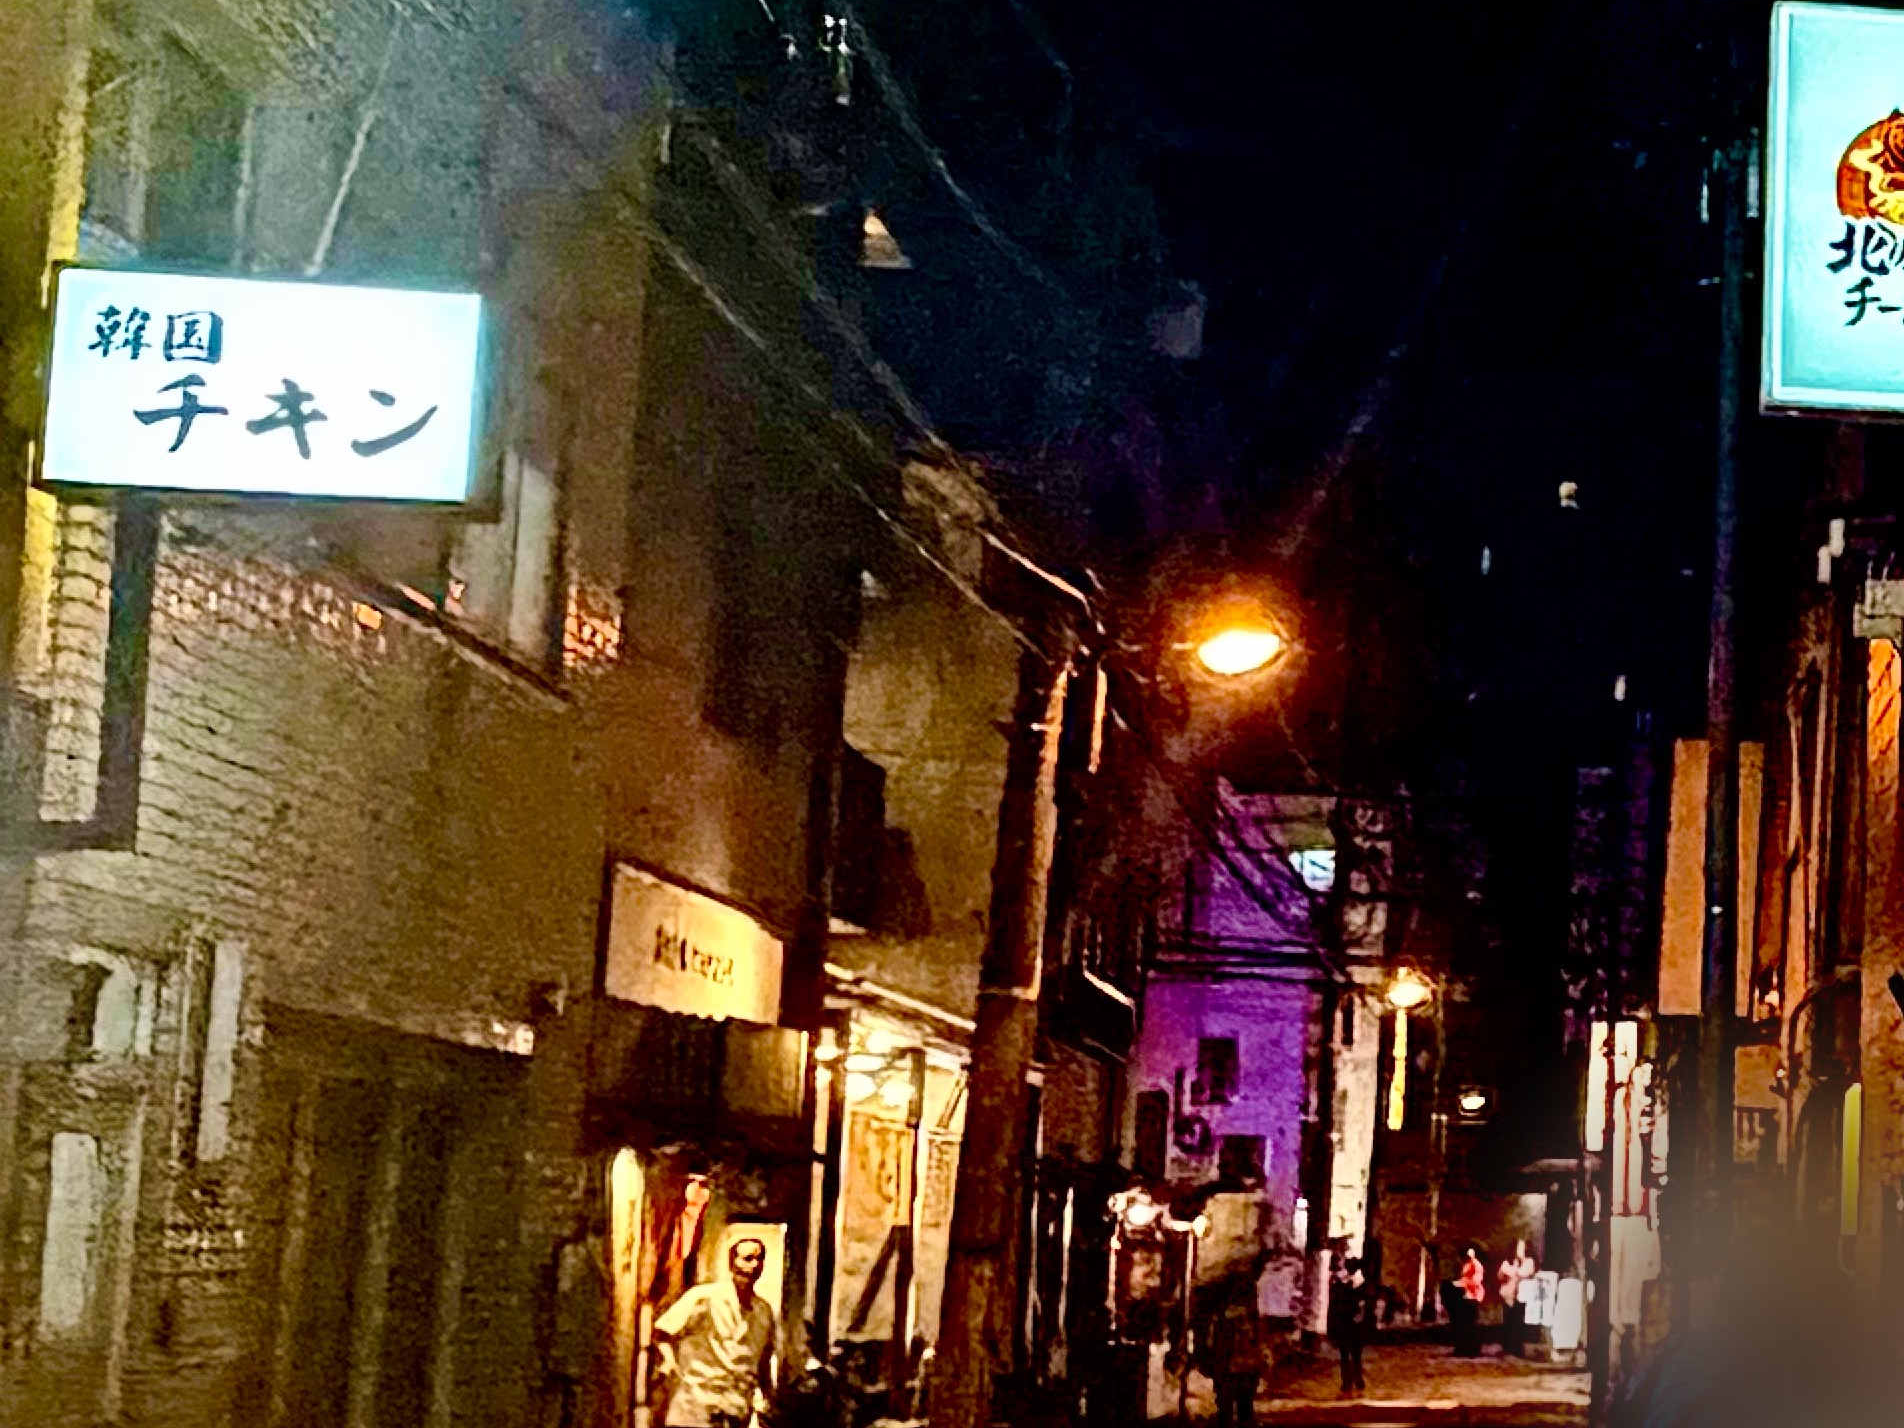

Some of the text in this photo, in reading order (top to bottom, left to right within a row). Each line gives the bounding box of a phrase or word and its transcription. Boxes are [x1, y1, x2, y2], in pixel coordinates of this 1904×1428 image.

[88, 305, 223, 364] 韓国
[133, 373, 438, 460] チキン
